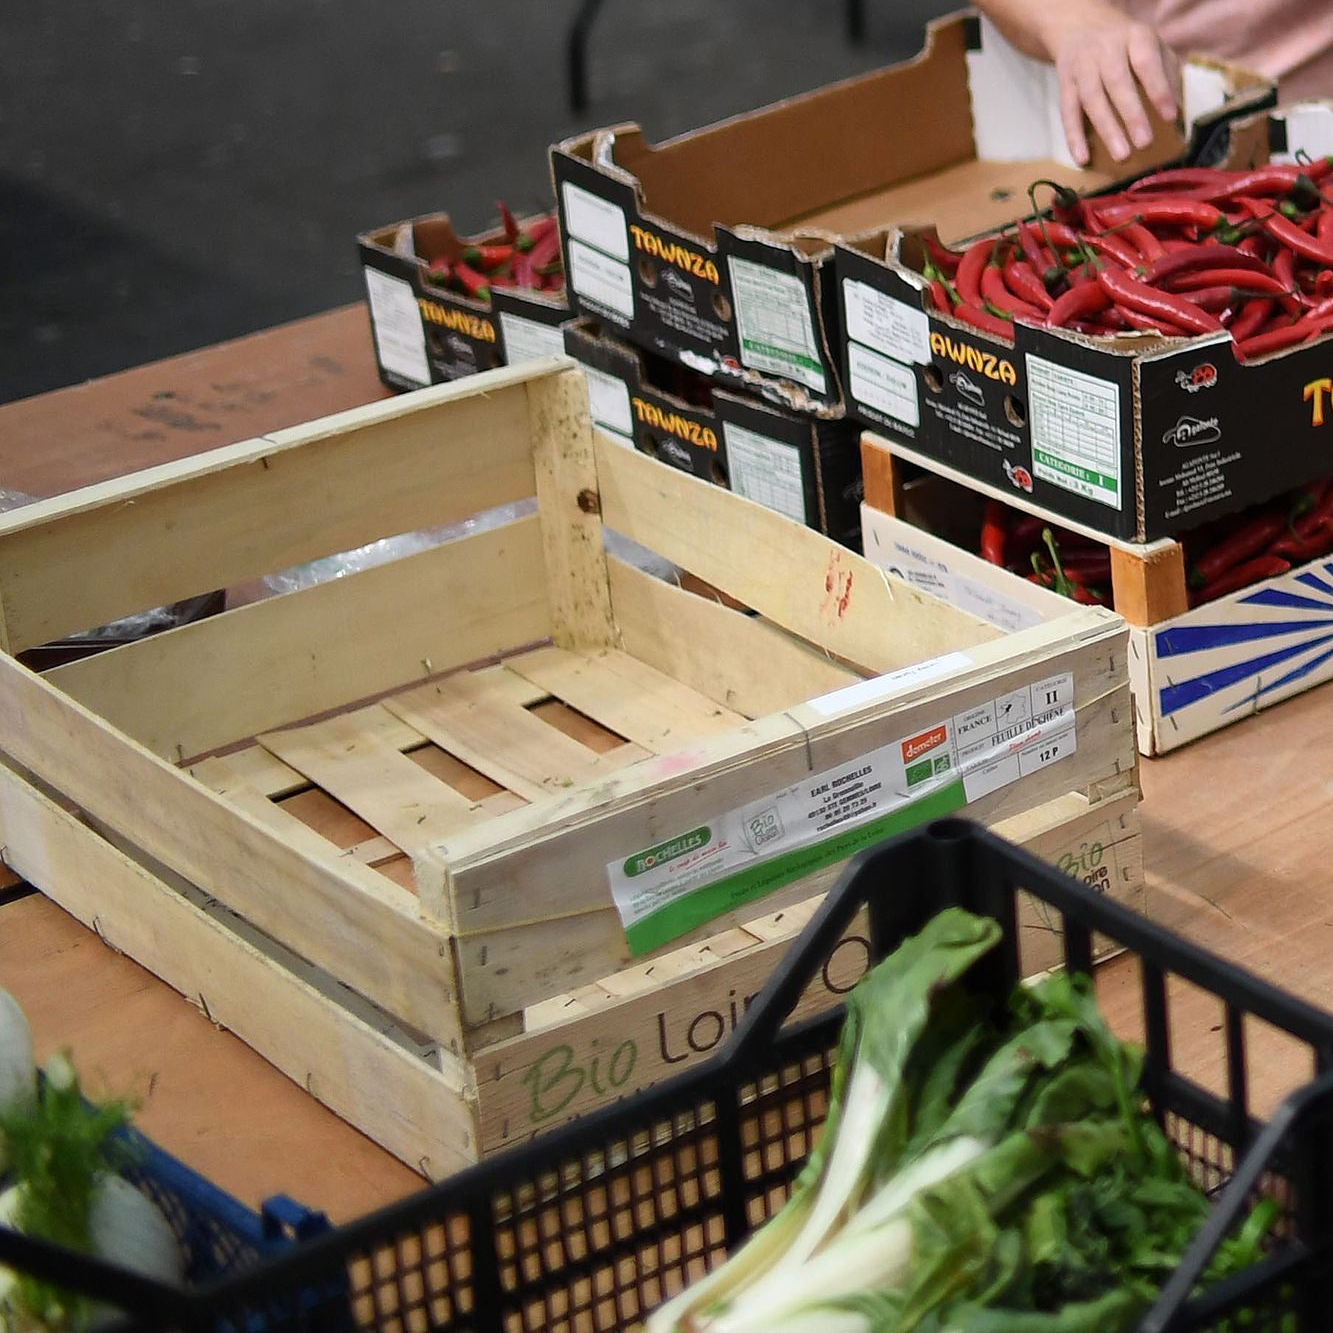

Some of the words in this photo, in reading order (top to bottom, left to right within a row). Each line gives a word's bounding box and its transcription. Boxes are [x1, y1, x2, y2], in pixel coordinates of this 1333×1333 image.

[630, 224, 719, 285] TAWNZA
[930, 333, 1016, 386] AWNZA
[632, 397, 718, 452] TAWNZA
[958, 715, 992, 734] FRANCE
[992, 723, 1024, 746] FEUILLE
[906, 732, 941, 757] demeter
[1040, 751, 1050, 762] 12
[1053, 747, 1058, 756] P
[1083, 866, 1108, 885] oire
[522, 1038, 638, 1123] Bio
